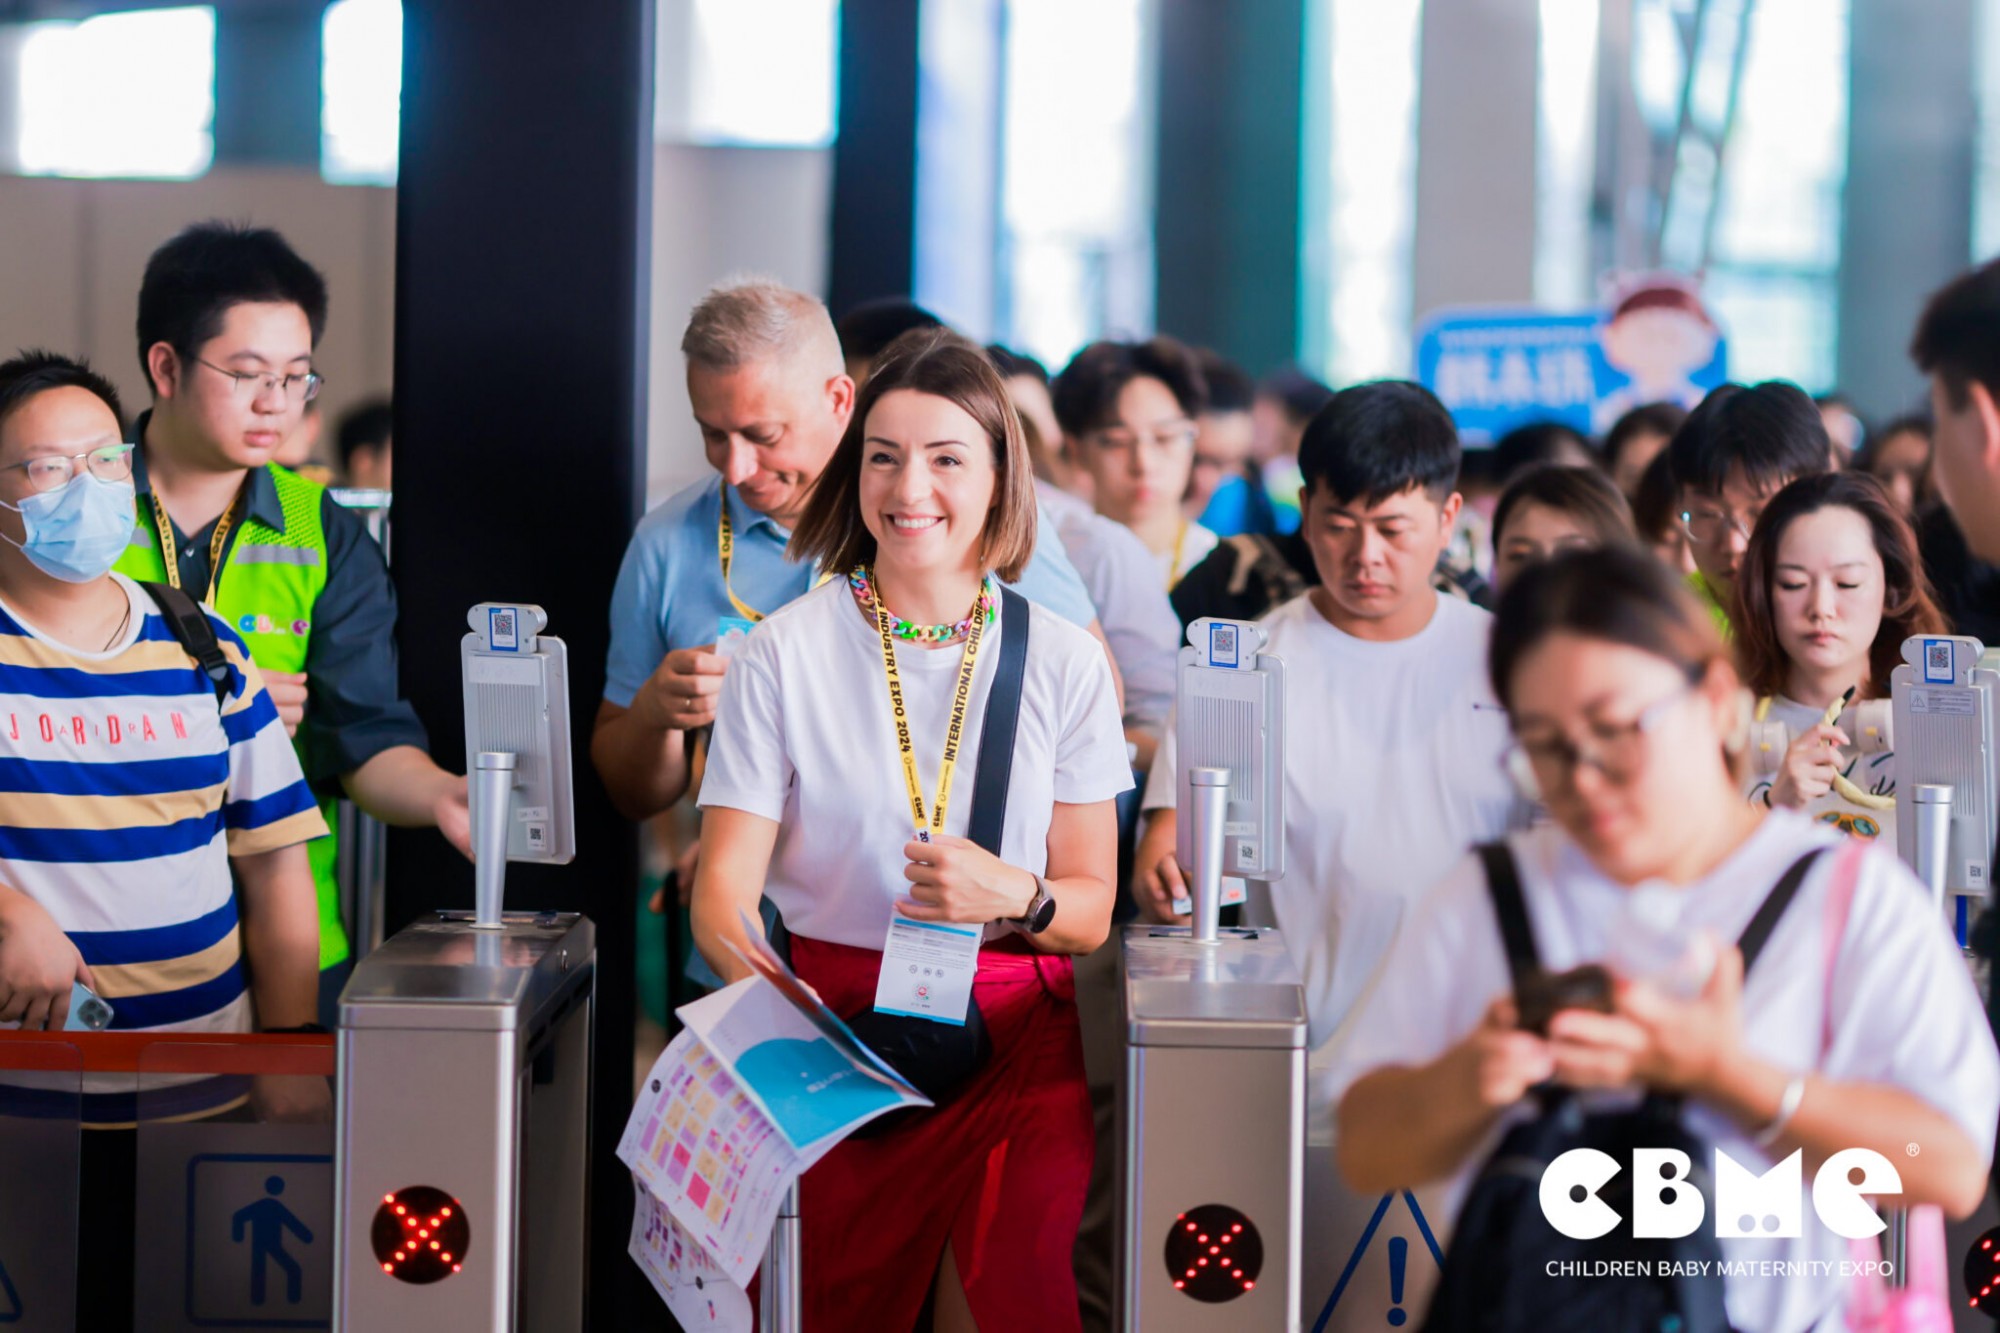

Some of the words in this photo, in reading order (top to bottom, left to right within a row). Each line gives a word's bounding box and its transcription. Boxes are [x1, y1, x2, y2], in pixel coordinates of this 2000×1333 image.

[239, 613, 309, 637] CBE
[880, 610, 898, 677] INDUSTRY
[889, 681, 905, 717] EXPO
[897, 721, 911, 753] 2024
[944, 660, 974, 762] INTERNATIONAL
